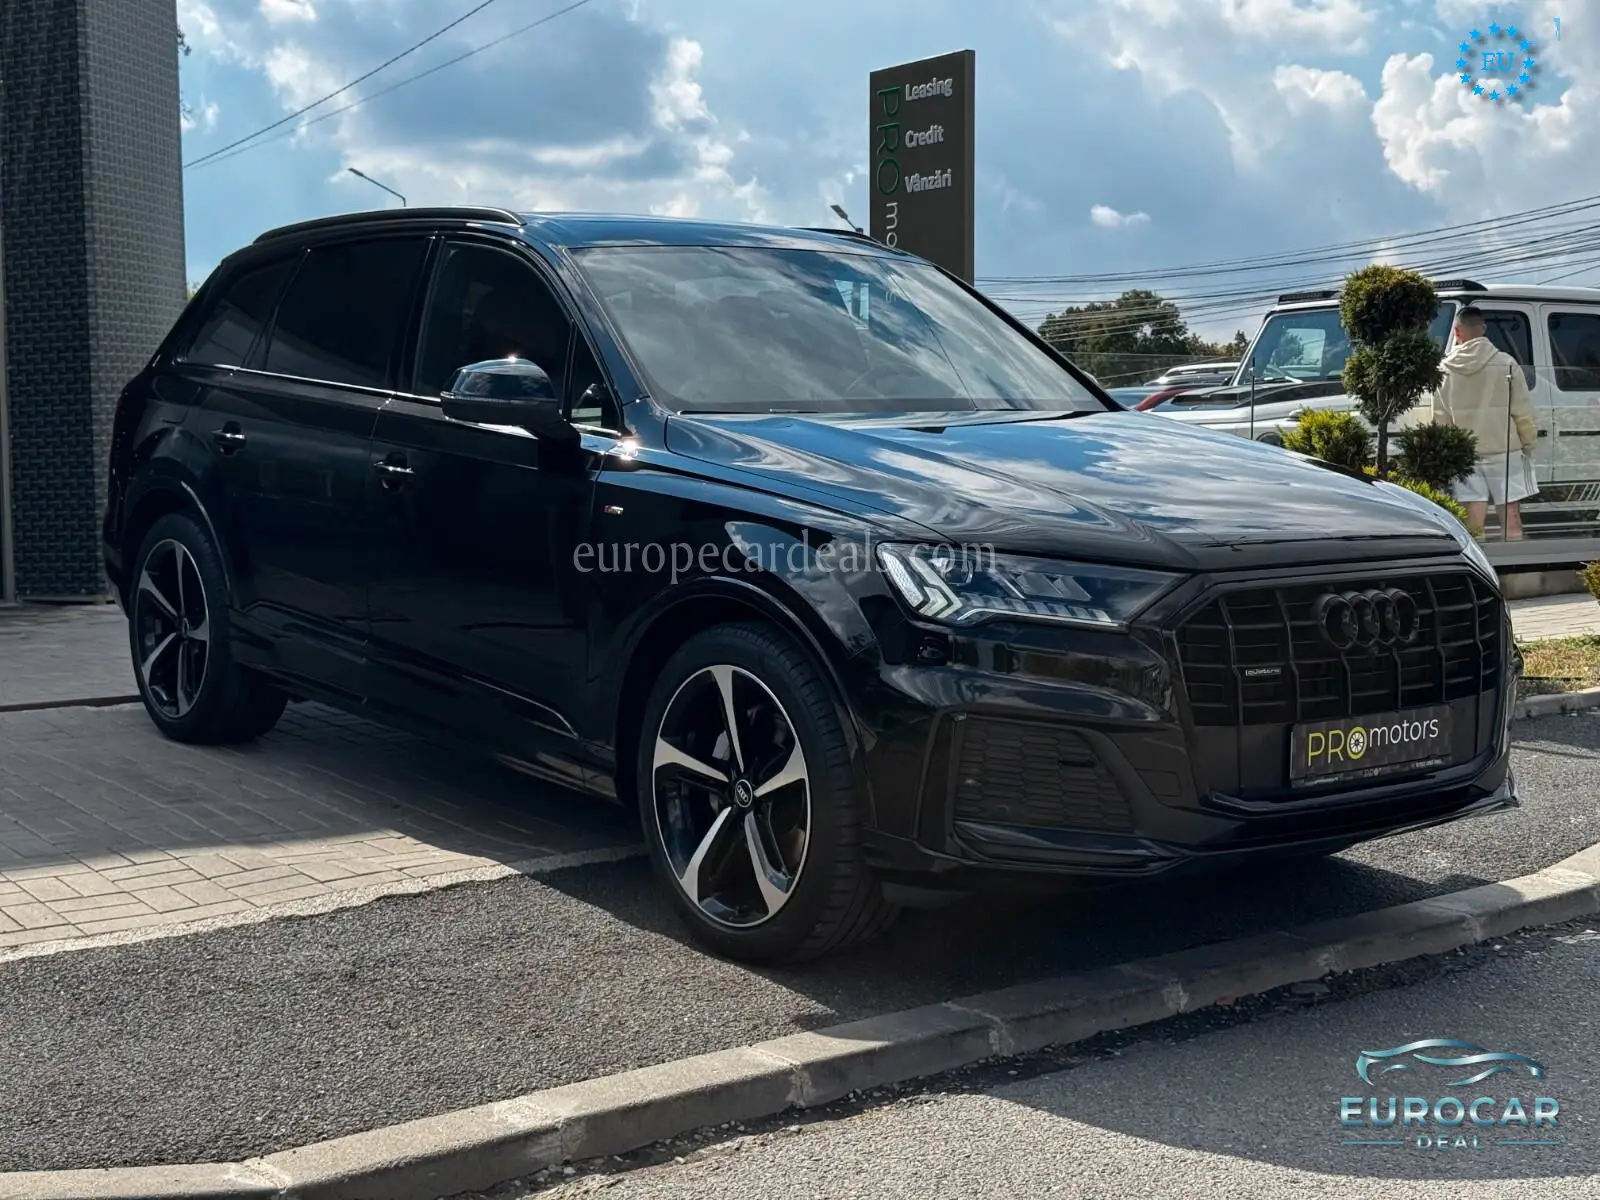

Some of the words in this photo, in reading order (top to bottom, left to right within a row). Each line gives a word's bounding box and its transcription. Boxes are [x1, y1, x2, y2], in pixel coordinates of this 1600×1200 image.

[905, 78, 953, 102] Leasing
[905, 125, 945, 148] Credit
[905, 168, 953, 193] Vânzări
